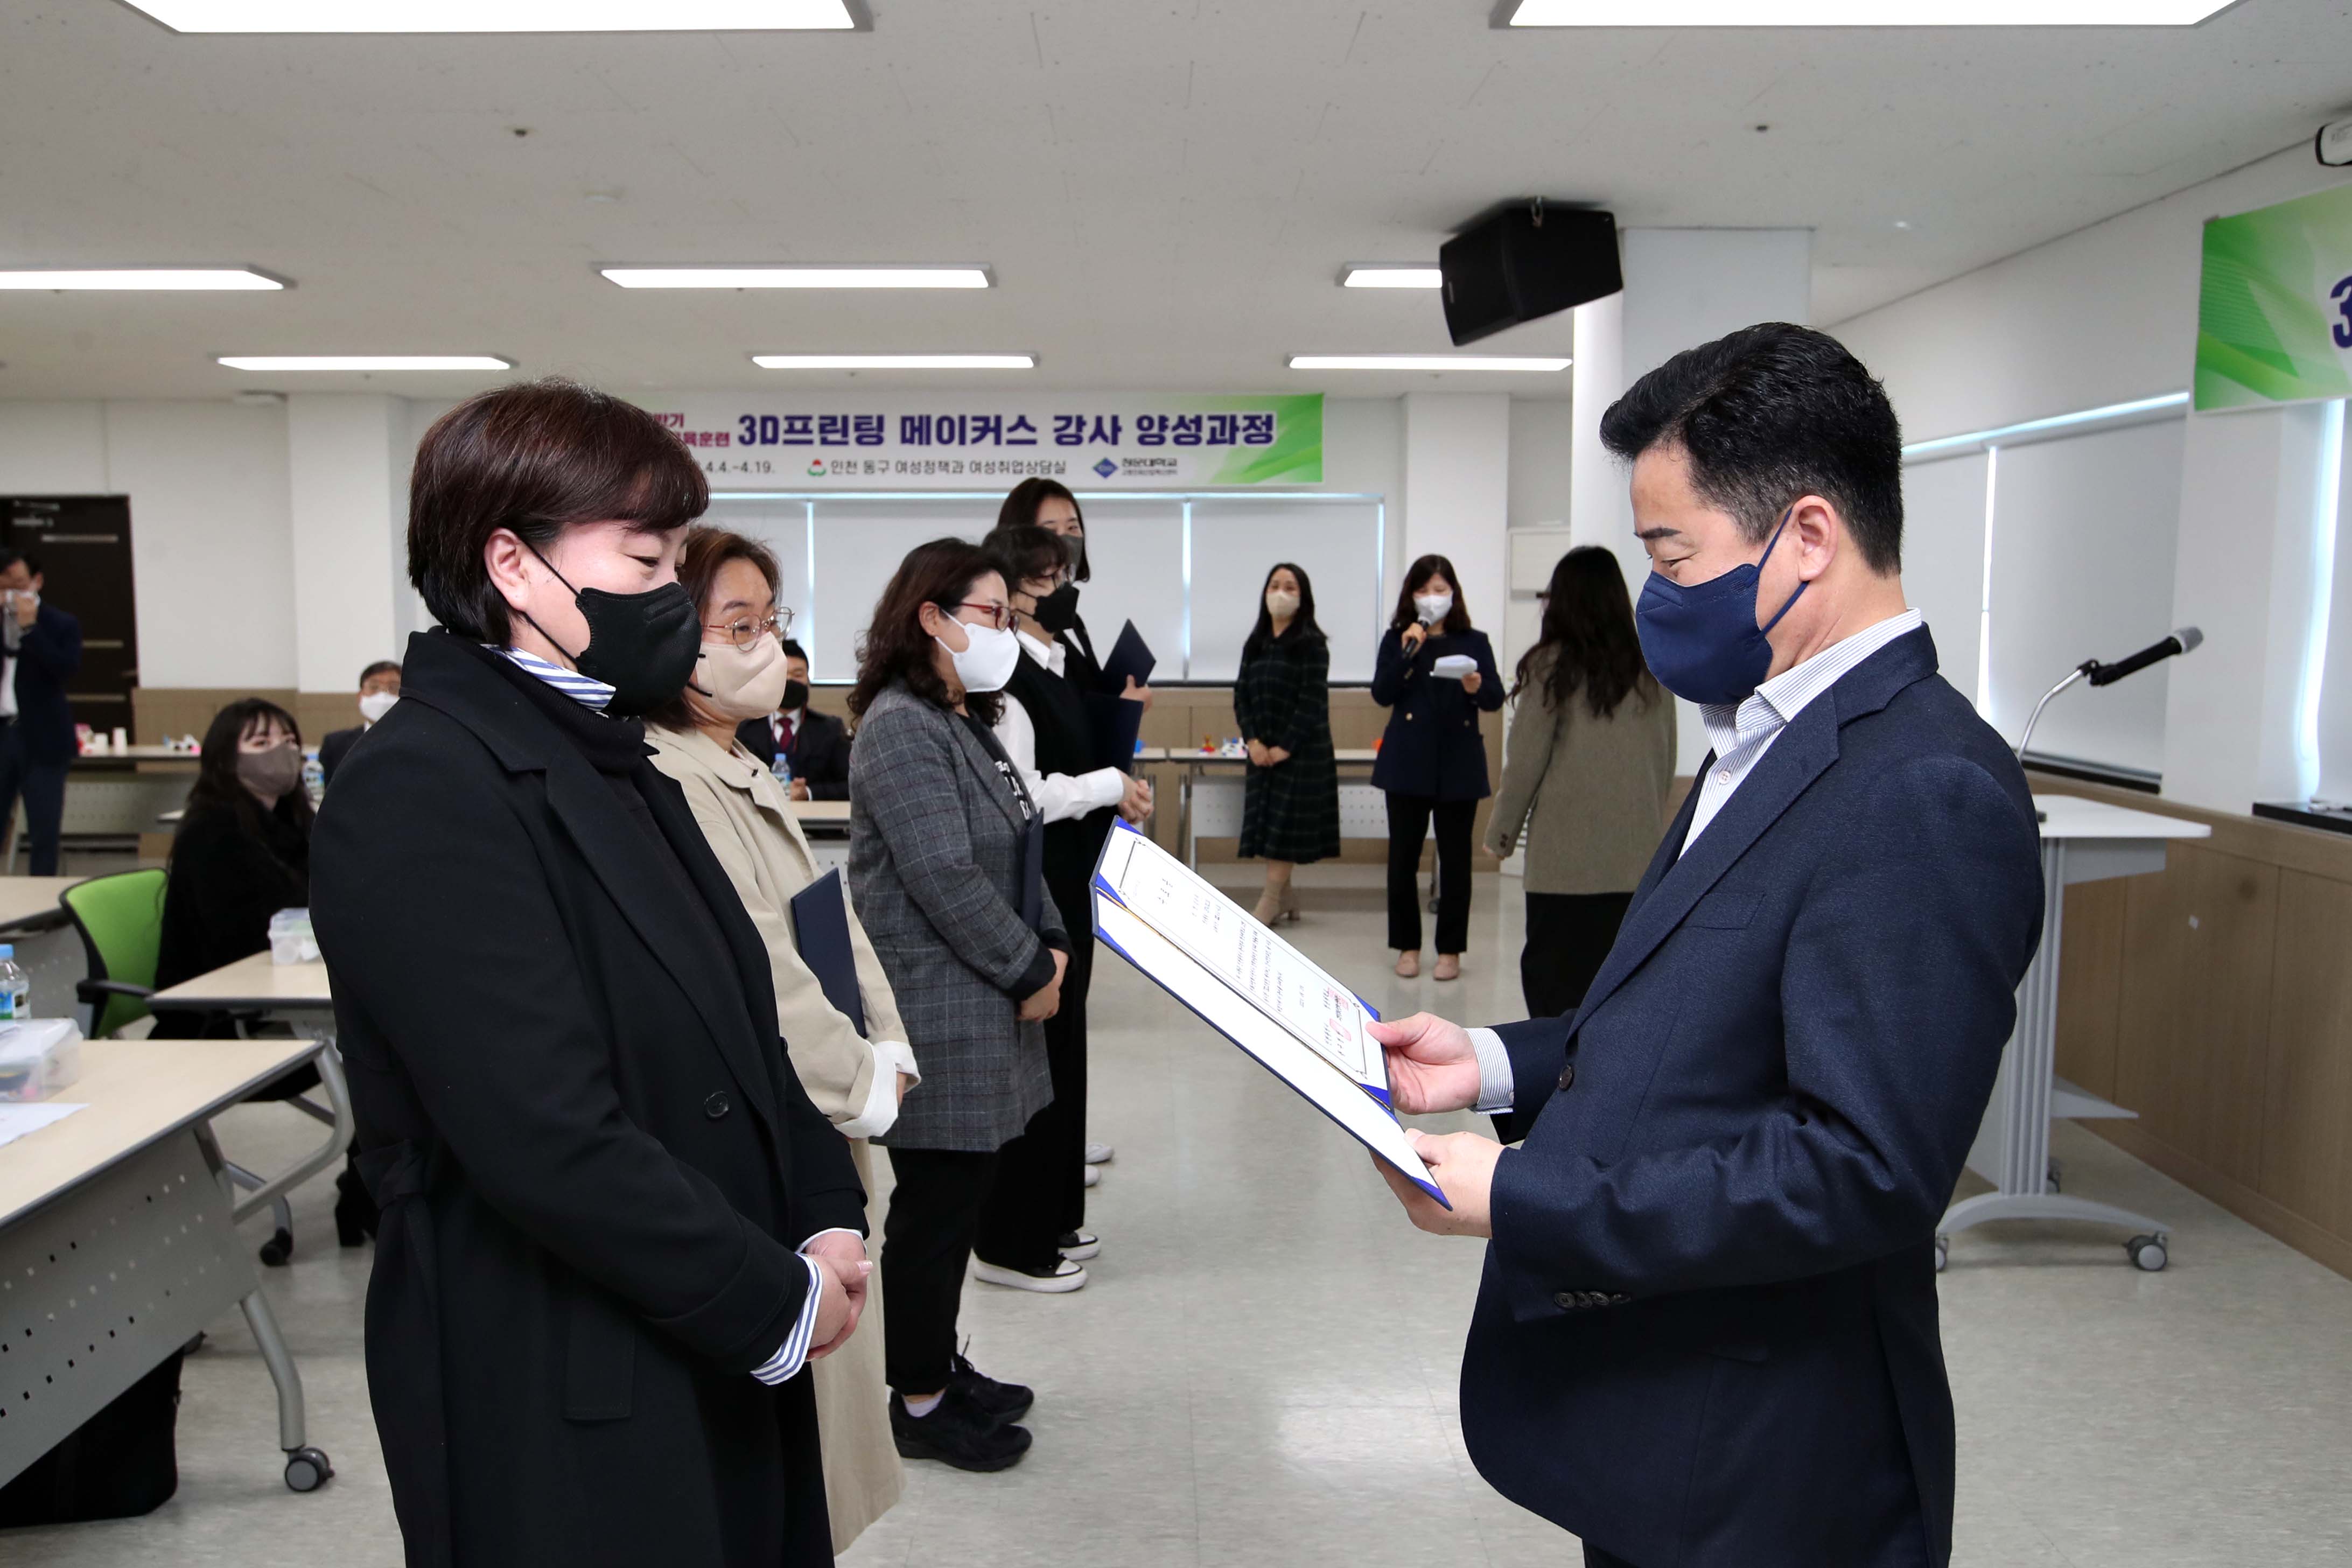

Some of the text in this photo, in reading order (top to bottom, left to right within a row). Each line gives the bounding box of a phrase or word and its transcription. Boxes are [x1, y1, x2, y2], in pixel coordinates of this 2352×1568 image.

[738, 414, 1274, 447] 3D프린팅 메이커스 강사 양성과정
[676, 431, 730, 447] 육훈련
[831, 459, 1066, 475] 인천 동구 여성정책과 여성취업상담실
